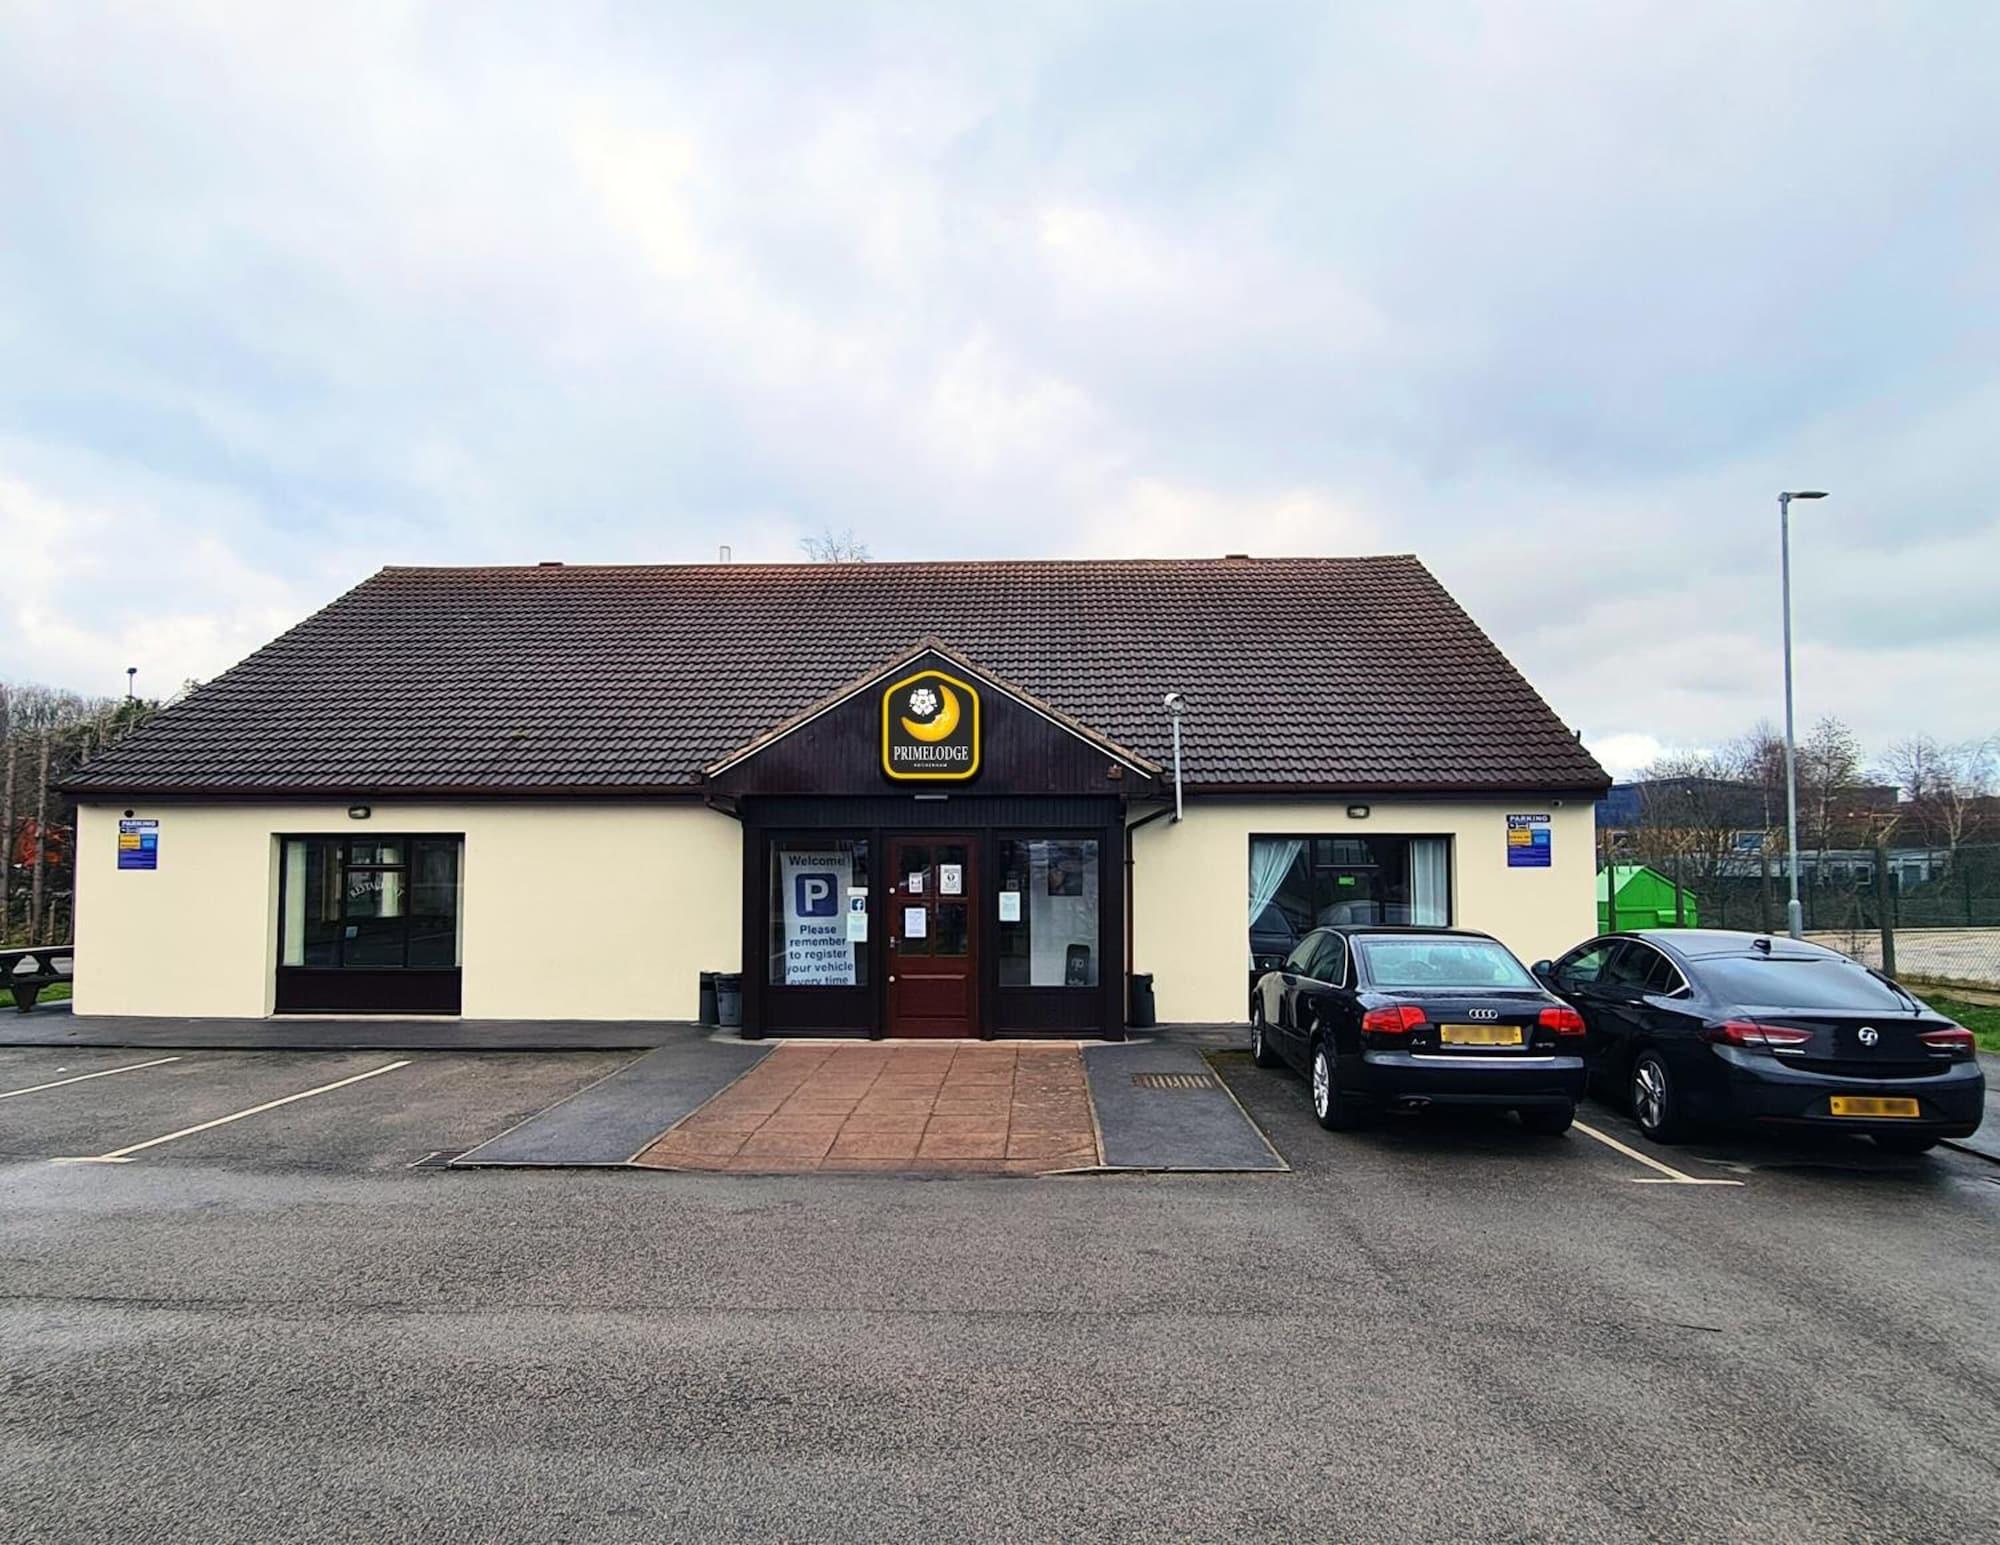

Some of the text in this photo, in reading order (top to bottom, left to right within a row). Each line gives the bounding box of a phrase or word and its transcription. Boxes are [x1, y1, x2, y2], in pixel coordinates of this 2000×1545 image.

[894, 746, 968, 761] PRIMELODGE
[804, 879, 829, 912] P
[799, 924, 837, 935] Please
[789, 937, 847, 947] remember
[789, 949, 848, 961] to register
[814, 960, 854, 972] vehicle
[825, 975, 849, 985] time
